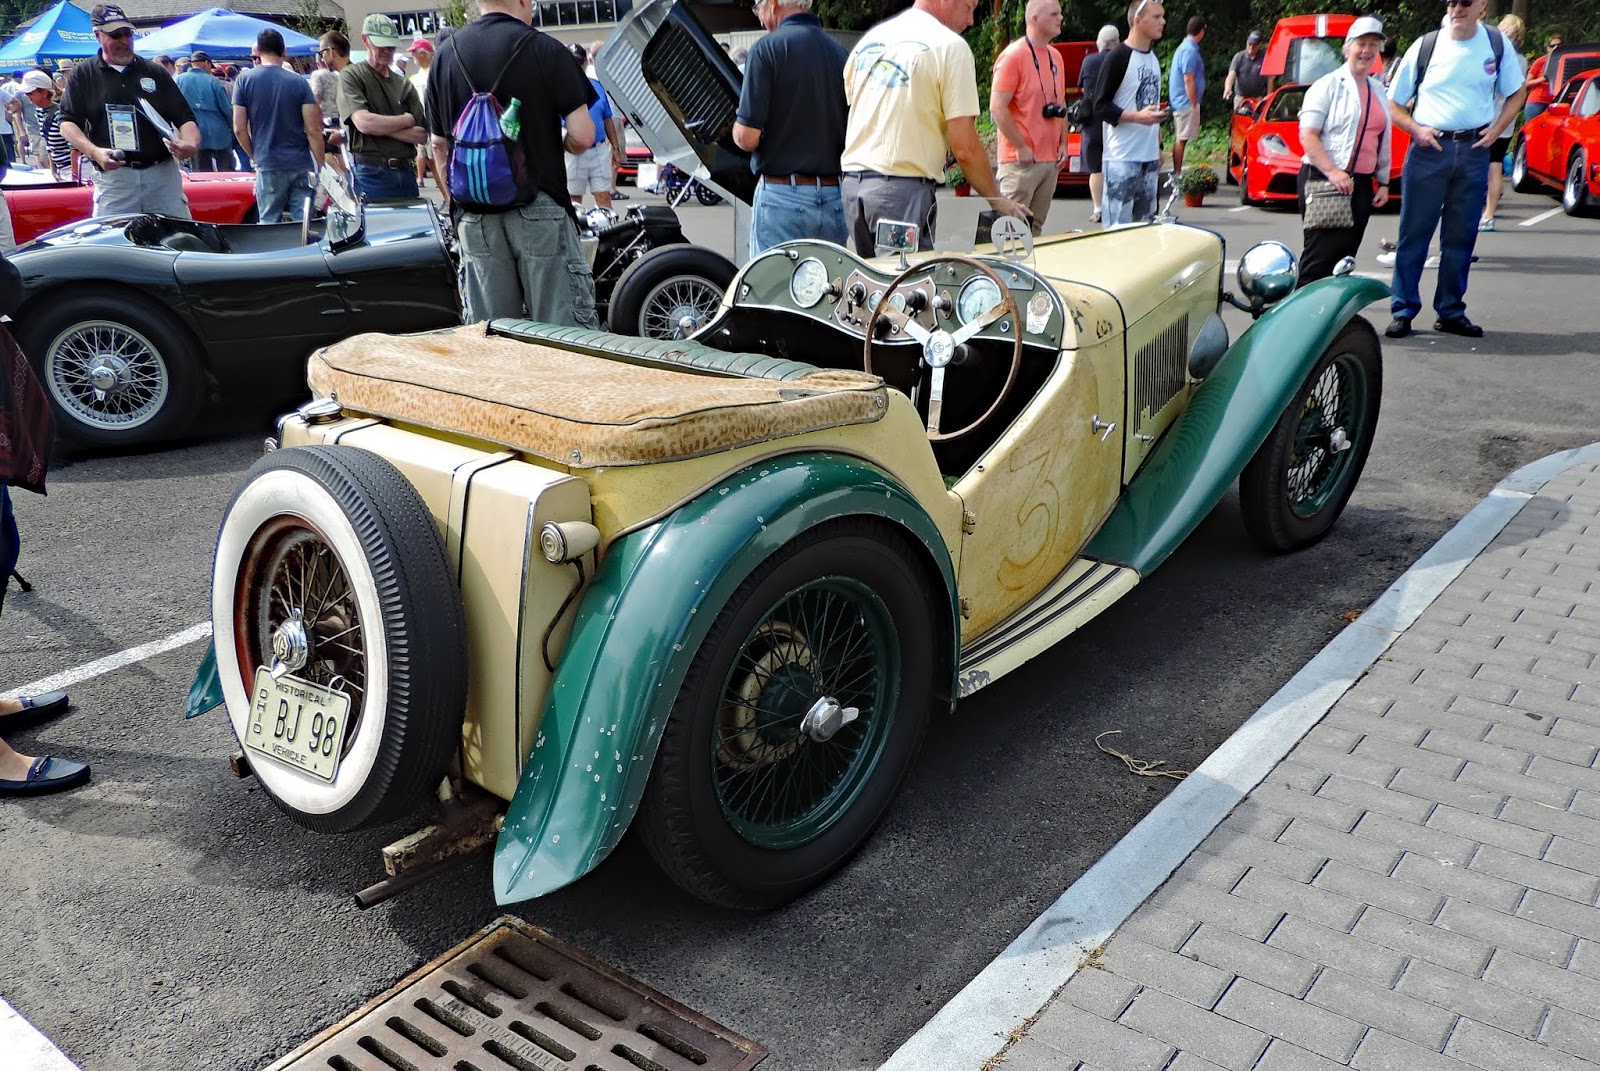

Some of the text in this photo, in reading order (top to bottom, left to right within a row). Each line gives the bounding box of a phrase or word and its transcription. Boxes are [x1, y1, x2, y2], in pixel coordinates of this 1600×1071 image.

[392, 17, 447, 31] AFE
[275, 682, 326, 707] HISTORICAL
[253, 688, 269, 735] OHIO
[274, 698, 338, 757] BJ 98
[272, 742, 307, 765] VEHICLE
[517, 1042, 554, 1067] IRON
